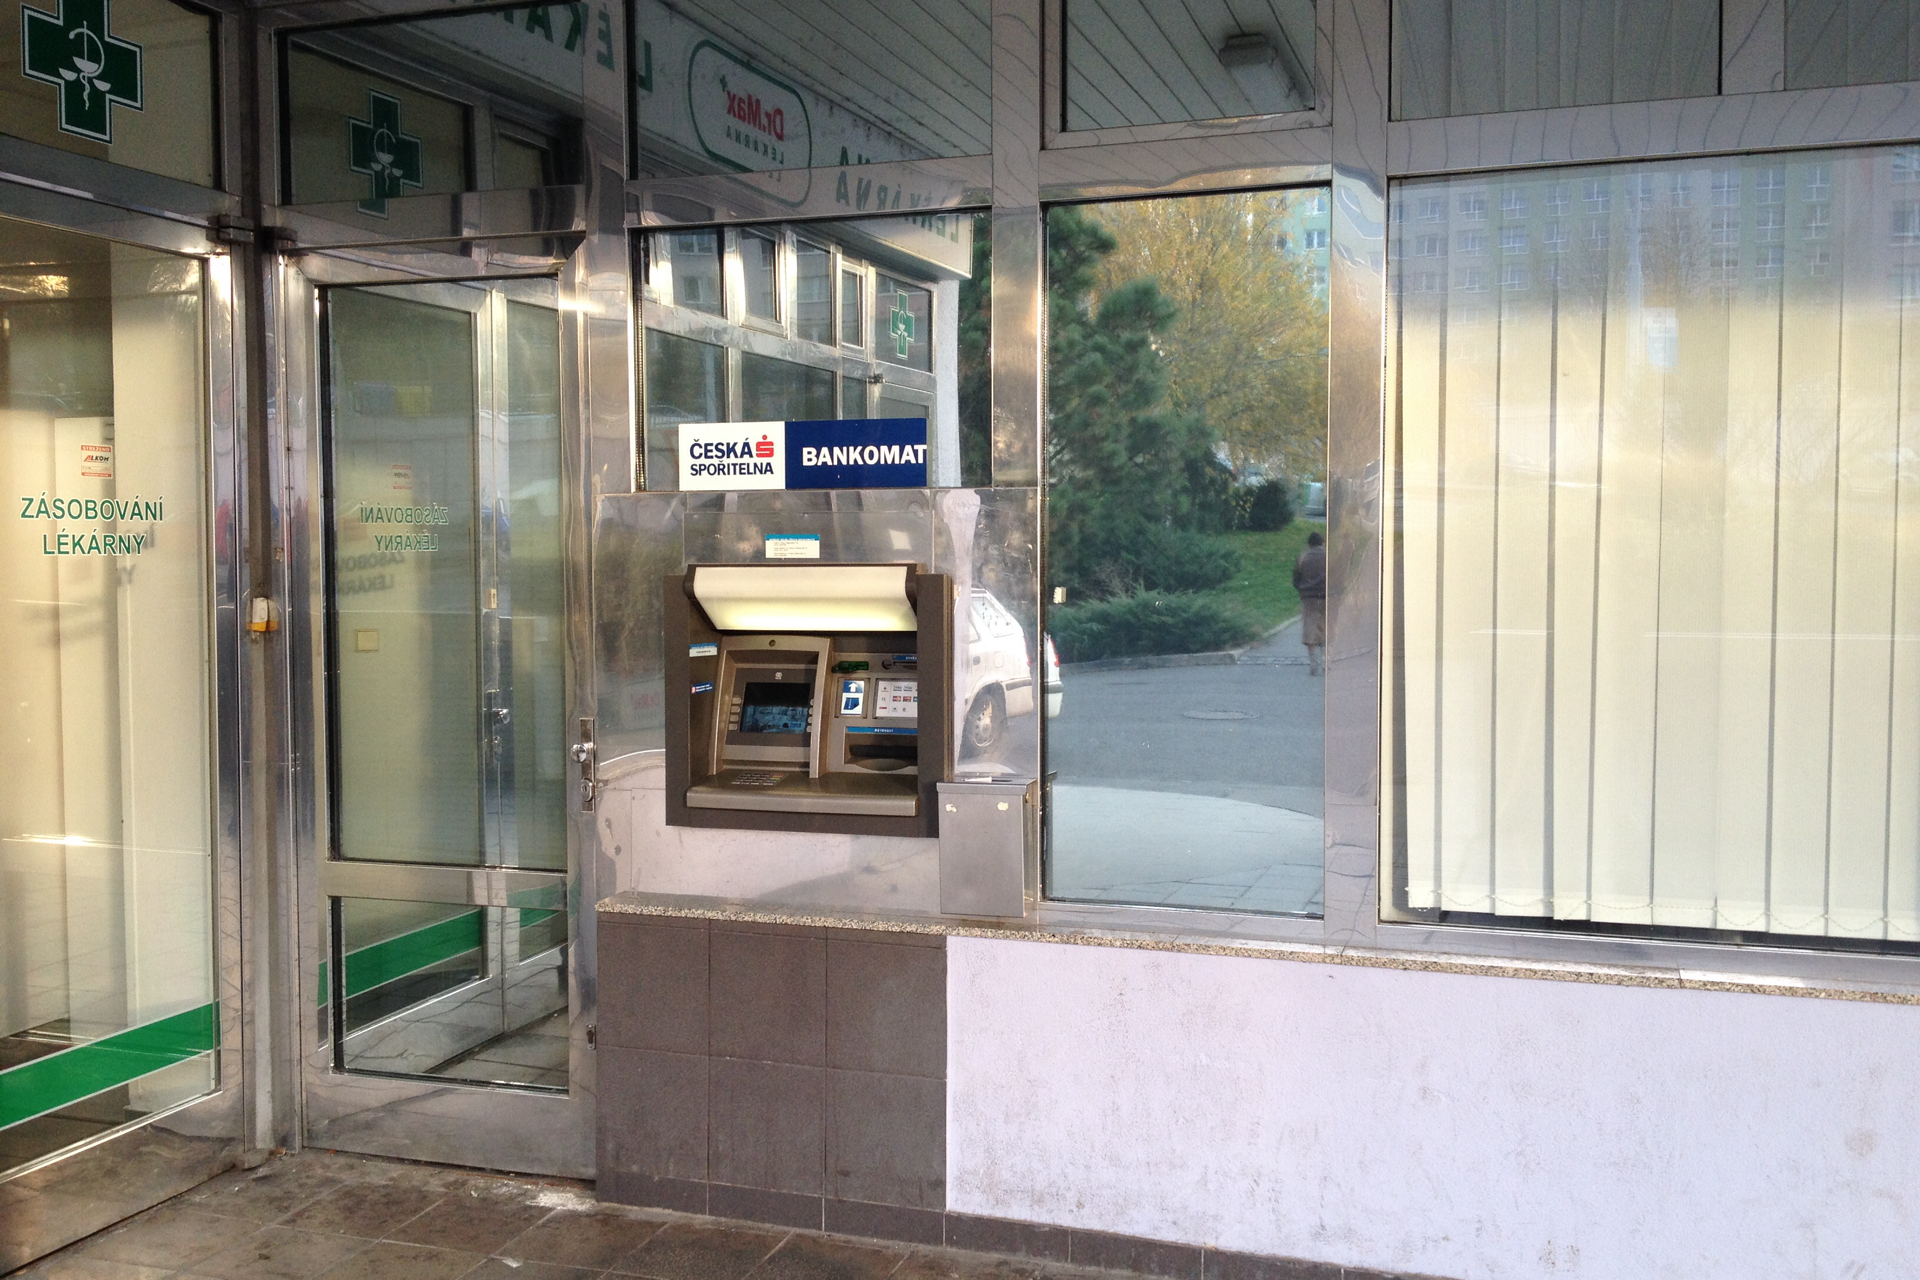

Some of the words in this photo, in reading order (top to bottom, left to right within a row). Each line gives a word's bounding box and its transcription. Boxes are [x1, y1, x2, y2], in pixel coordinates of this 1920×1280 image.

[689, 437, 754, 460] ČESKÁ
[802, 444, 927, 466] BANKOMAT
[689, 460, 774, 476] SPOŘITELNA
[20, 491, 164, 521] ZÁSOBOVÁNÍ
[42, 527, 146, 556] LÉKÁRNY
